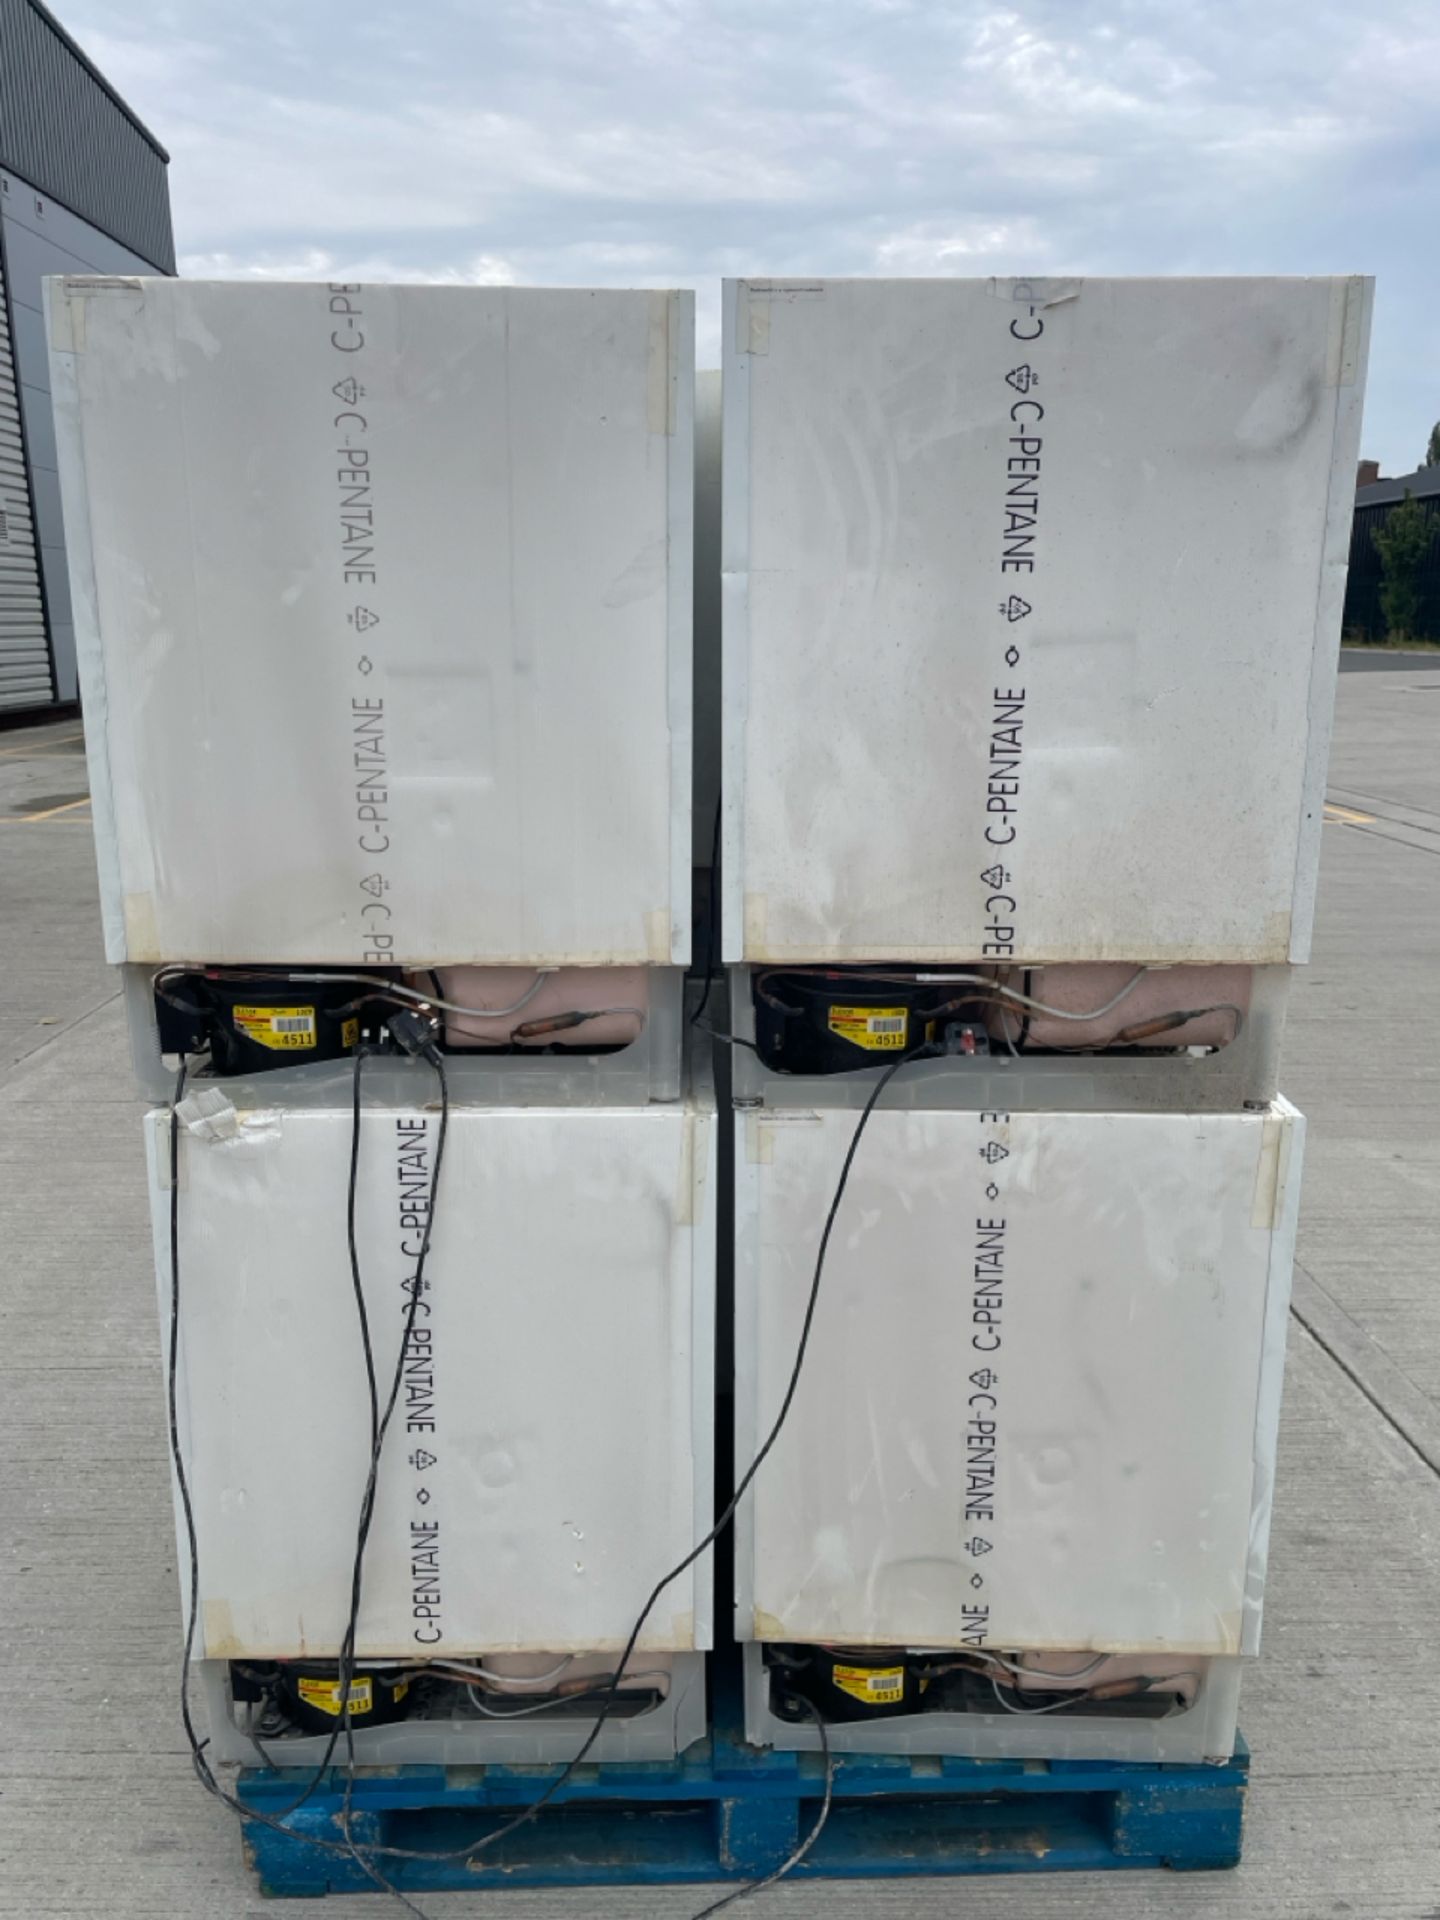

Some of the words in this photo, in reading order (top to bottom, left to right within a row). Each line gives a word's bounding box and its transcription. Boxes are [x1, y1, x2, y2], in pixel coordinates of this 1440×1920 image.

[1010, 277, 1045, 340] C-P
[334, 412, 376, 585] C-PENTANE
[1001, 401, 1044, 574] C-PENTANE
[352, 697, 390, 854] C-PENTANE
[984, 687, 1026, 846] C-PENTANE
[282, 1032, 313, 1045] 4511
[397, 1119, 432, 1258] C-PENTANE
[972, 1218, 1007, 1352] C-PENTANE
[965, 1393, 997, 1521] C-PENTANE
[410, 1520, 443, 1644] C-PENTANE
[960, 1603, 990, 1647] ANE
